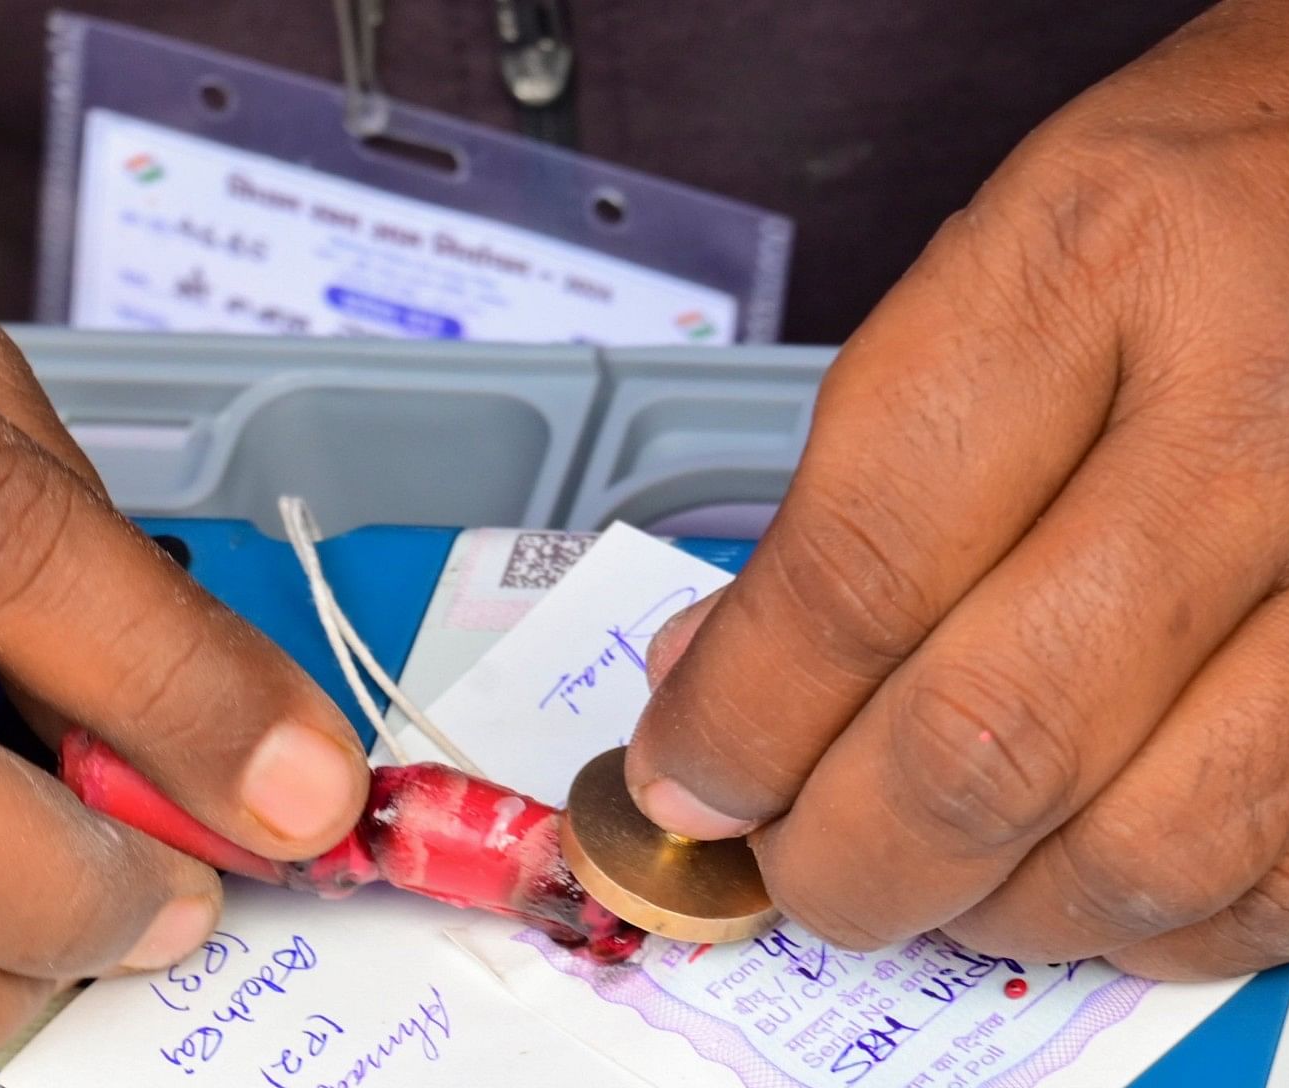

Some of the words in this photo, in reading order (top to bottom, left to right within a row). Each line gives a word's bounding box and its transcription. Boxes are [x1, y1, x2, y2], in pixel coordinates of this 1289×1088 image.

[705, 957, 765, 1000] From
[753, 1005, 793, 1046] BU
[801, 1019, 863, 1069] Serial
[899, 958, 940, 993] and
[963, 1043, 1006, 1077] Poll
